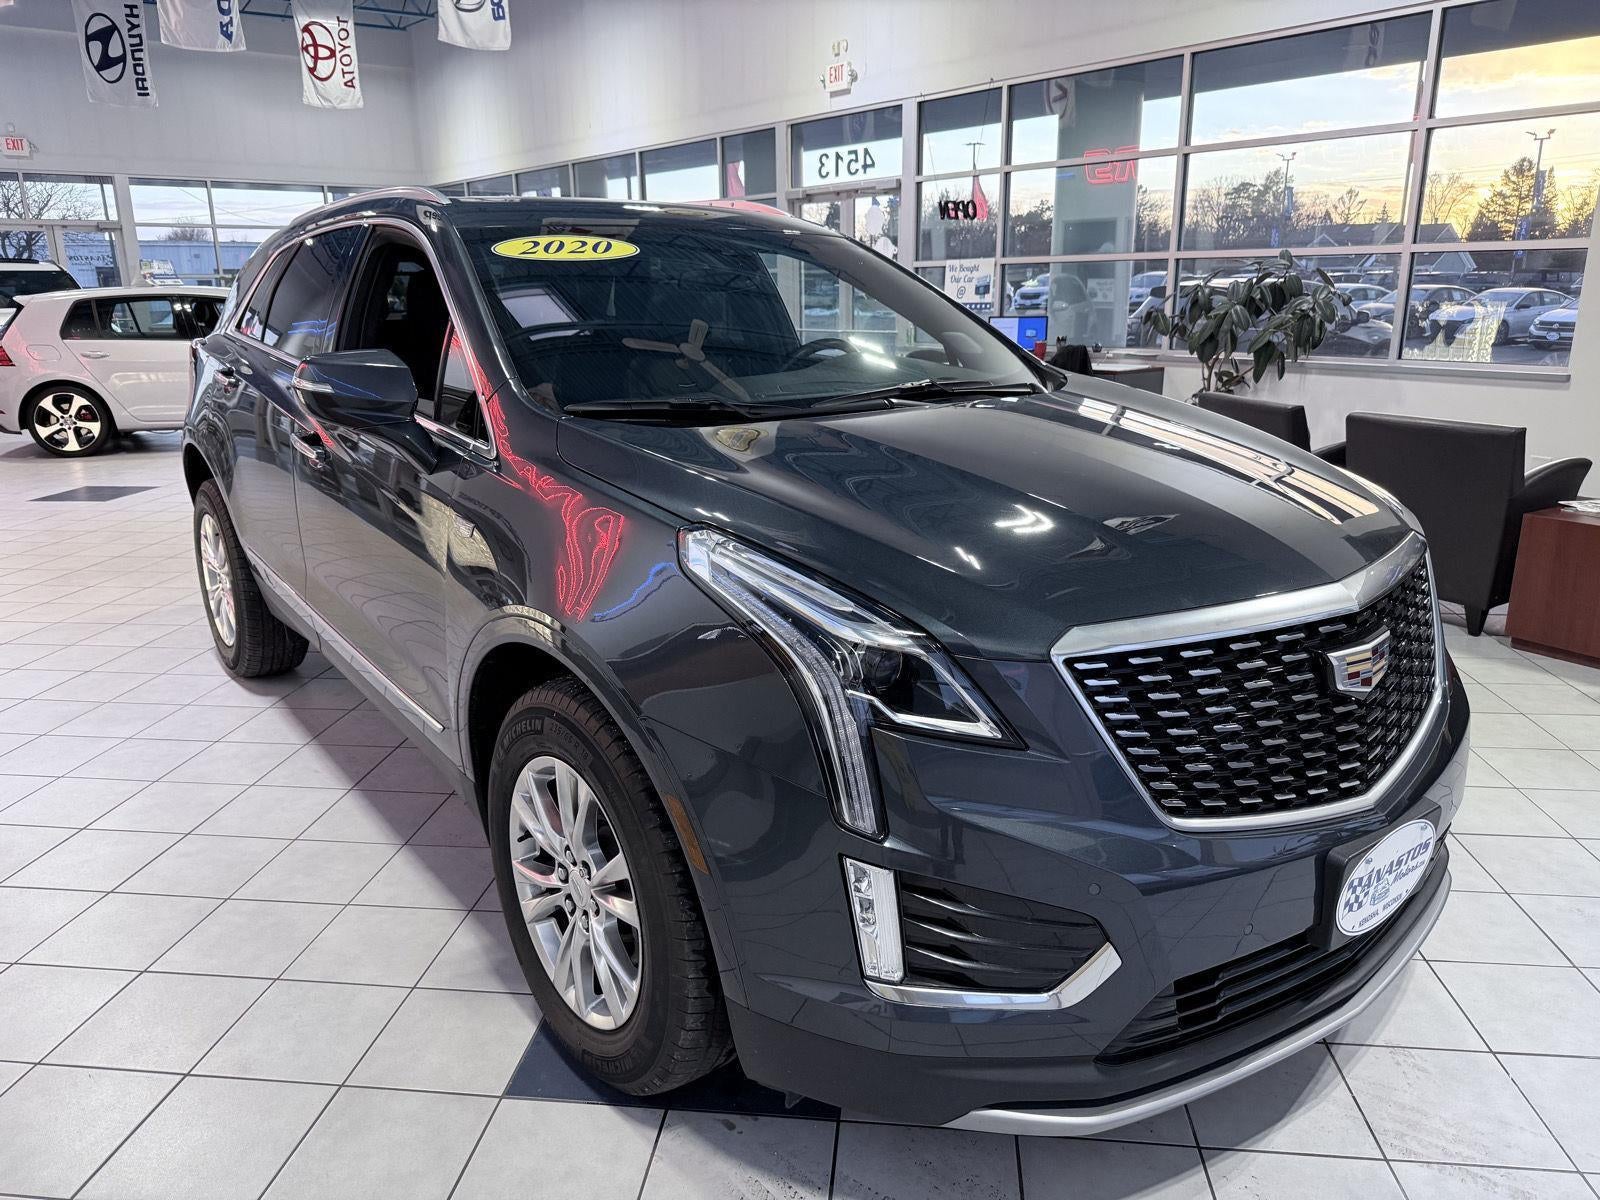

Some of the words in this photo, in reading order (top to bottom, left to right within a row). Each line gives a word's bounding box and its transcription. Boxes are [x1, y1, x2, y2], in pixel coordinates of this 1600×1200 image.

[829, 64, 844, 83] EXIT
[5, 137, 25, 151] EXIT
[518, 239, 613, 255] 2020
[948, 263, 958, 272] We
[959, 263, 980, 273] Bought
[503, 718, 542, 746] MICHELIN
